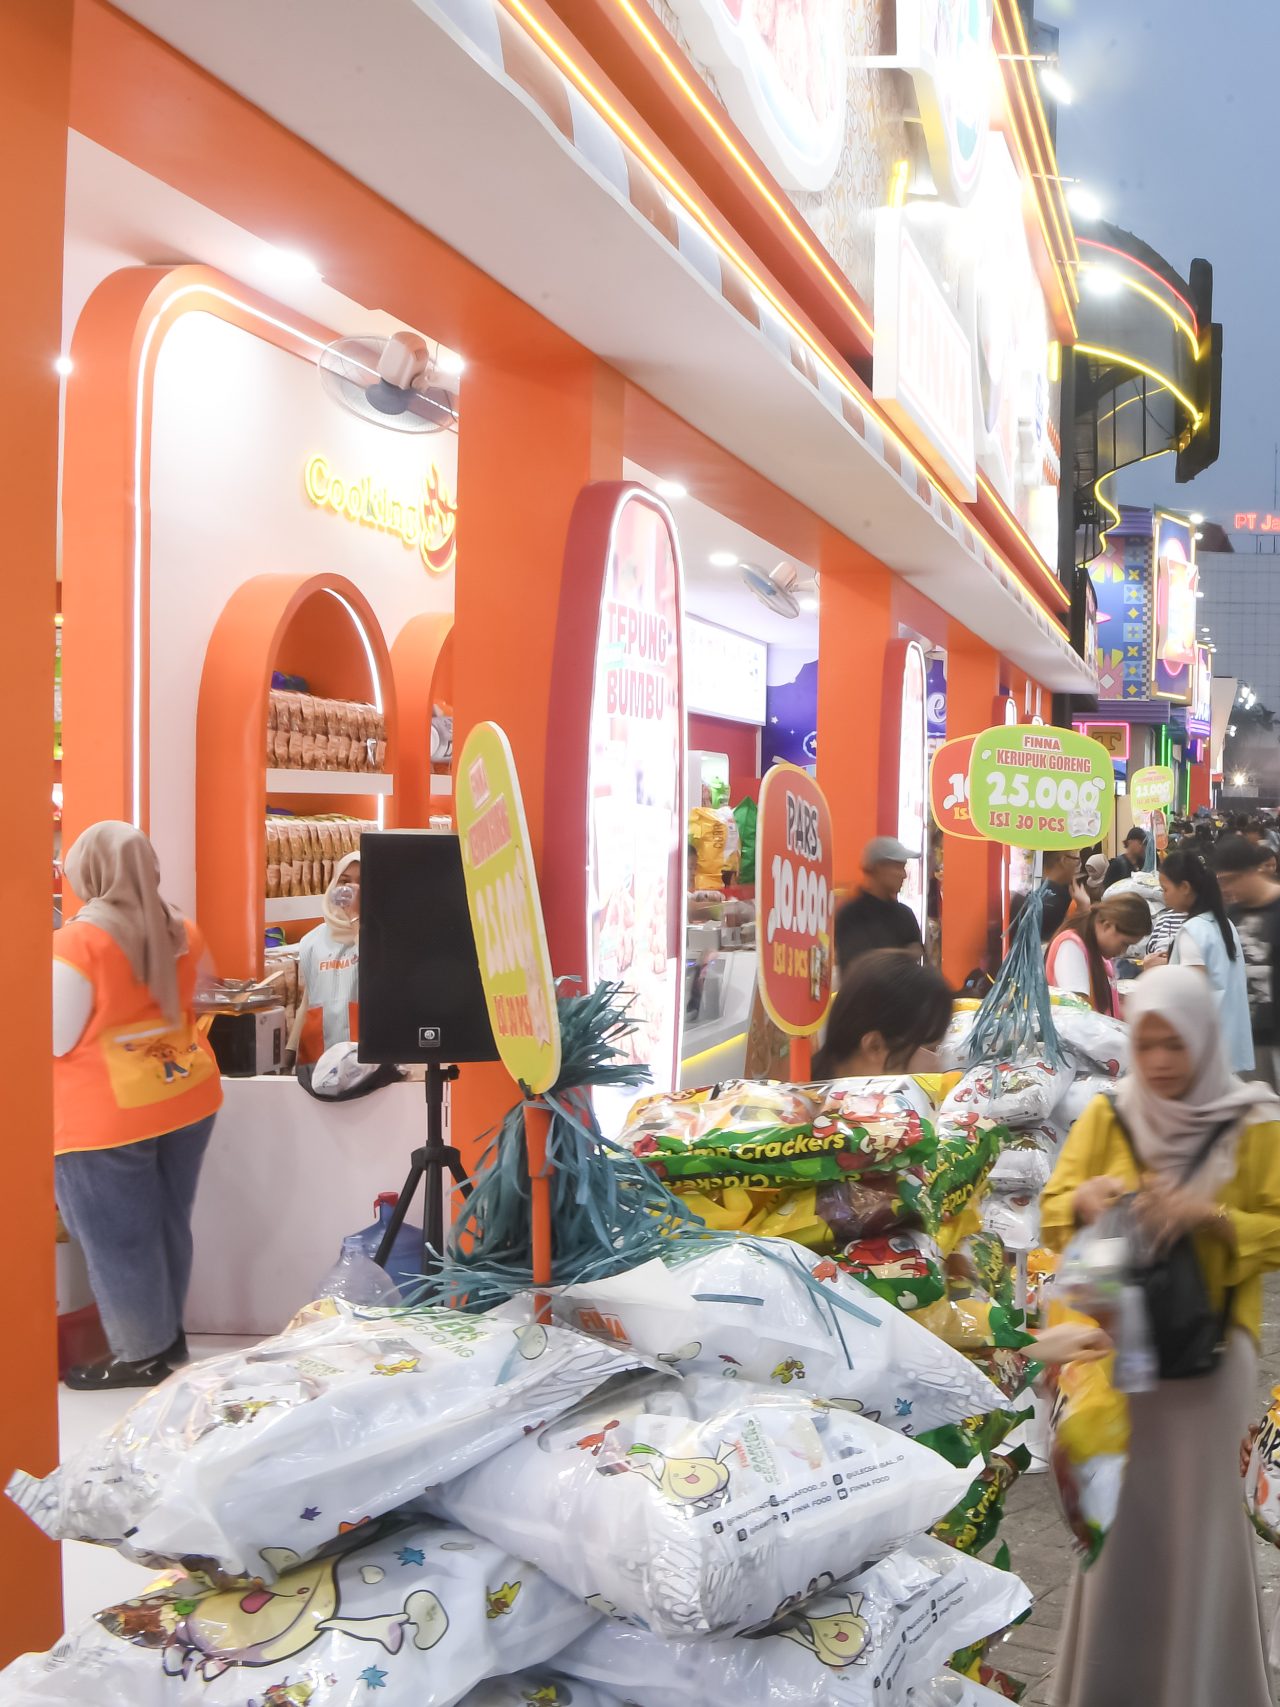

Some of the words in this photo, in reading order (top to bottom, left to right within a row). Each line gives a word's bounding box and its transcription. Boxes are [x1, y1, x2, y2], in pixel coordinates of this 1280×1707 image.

[304, 454, 420, 545] Cooking
[1234, 513, 1257, 530] PT
[607, 602, 668, 663] TEPUNG
[606, 669, 665, 720] BUMBU
[1023, 735, 1061, 751] FINNA
[996, 749, 1047, 768] KERUPUK
[1049, 754, 1091, 773] GORENG
[986, 771, 1098, 811] 25.000
[786, 790, 821, 861] PARS
[989, 811, 1011, 827] ISI
[1015, 814, 1033, 830] 30
[1038, 816, 1065, 832] PCS
[319, 959, 350, 971] FINNA
[735, 1131, 846, 1161] Crackers
